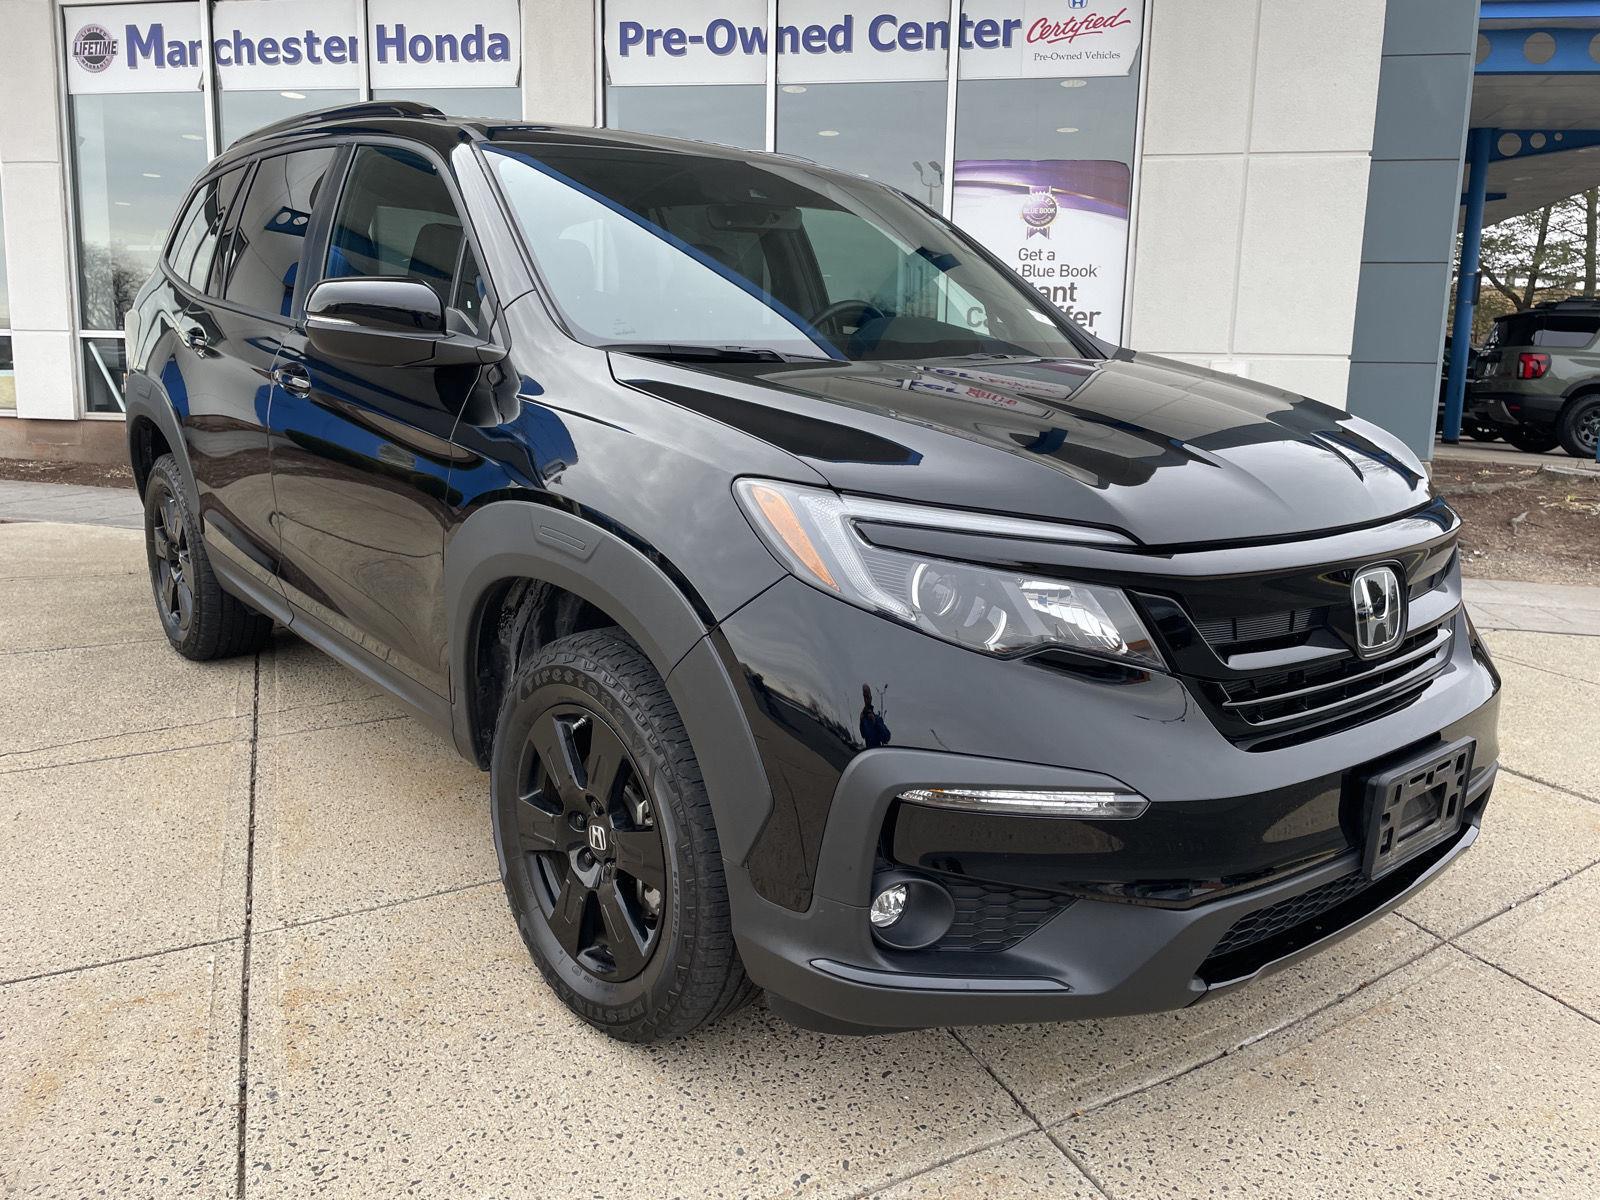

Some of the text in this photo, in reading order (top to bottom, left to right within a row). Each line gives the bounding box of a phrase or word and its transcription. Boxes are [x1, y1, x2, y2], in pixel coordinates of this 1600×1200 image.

[1026, 7, 1131, 44] Certified
[619, 13, 1022, 57] Pre-Owned Center
[74, 41, 117, 55] LIFETIME
[376, 23, 511, 64] Honda
[1034, 51, 1121, 61] Pre-Owned Vehicles
[1018, 247, 1056, 261] Get a
[1022, 264, 1098, 278] Blue Book
